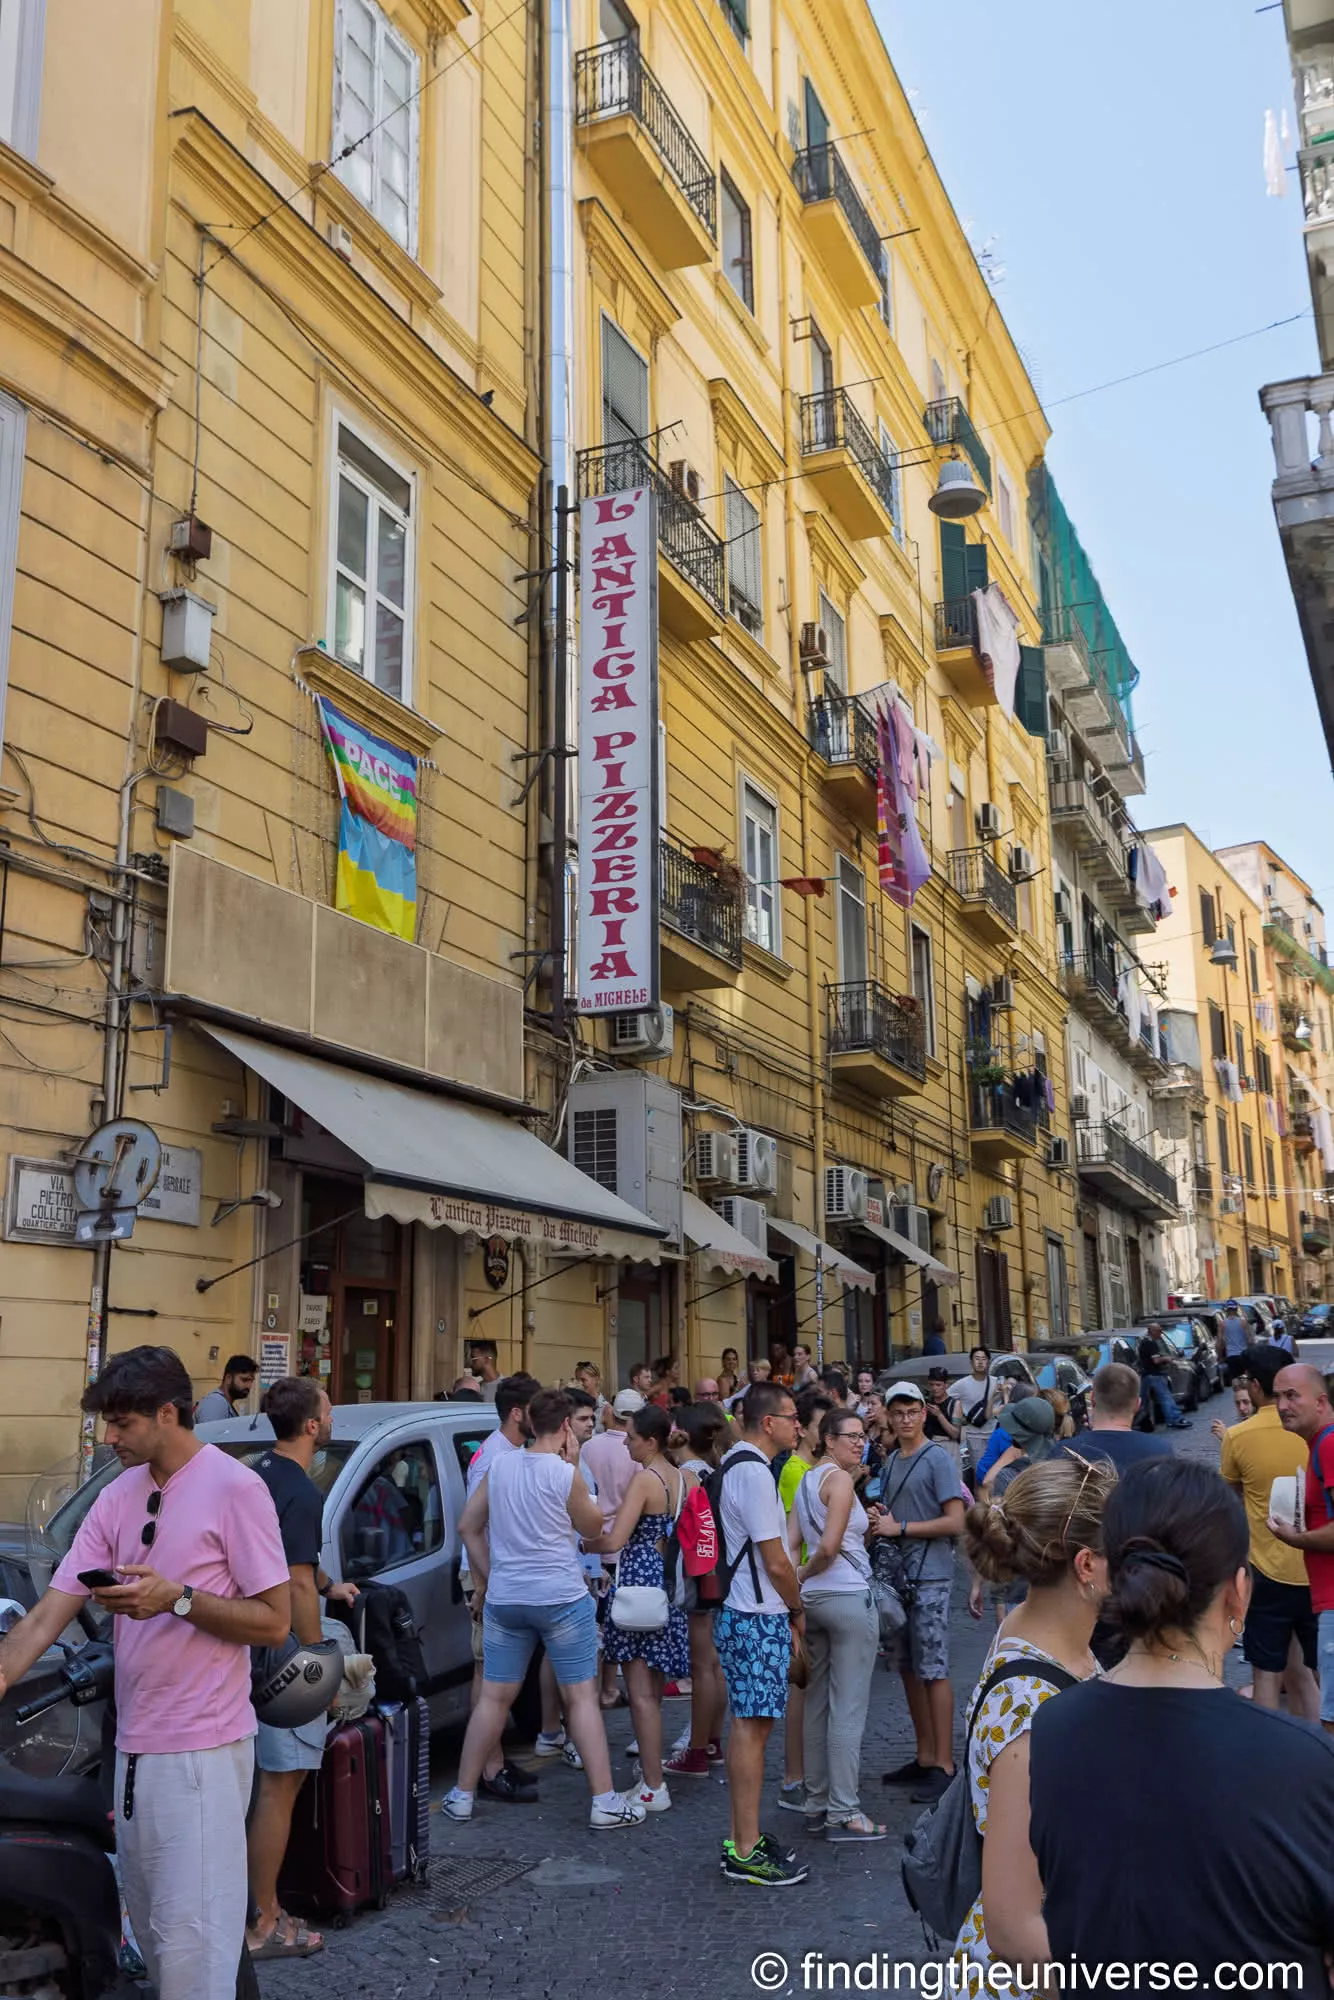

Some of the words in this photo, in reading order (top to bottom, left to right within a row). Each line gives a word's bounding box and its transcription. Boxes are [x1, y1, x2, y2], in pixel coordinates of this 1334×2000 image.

[345, 738, 401, 800] PACE
[589, 731, 640, 981] PIZZERIA
[580, 996, 592, 1008] da
[50, 1175, 65, 1191] VIA
[40, 1190, 74, 1207] PIETRO
[22, 1218, 58, 1230] QUARTIERE
[430, 1196, 482, 1227] L'antica
[485, 1204, 532, 1235] Pizzeria
